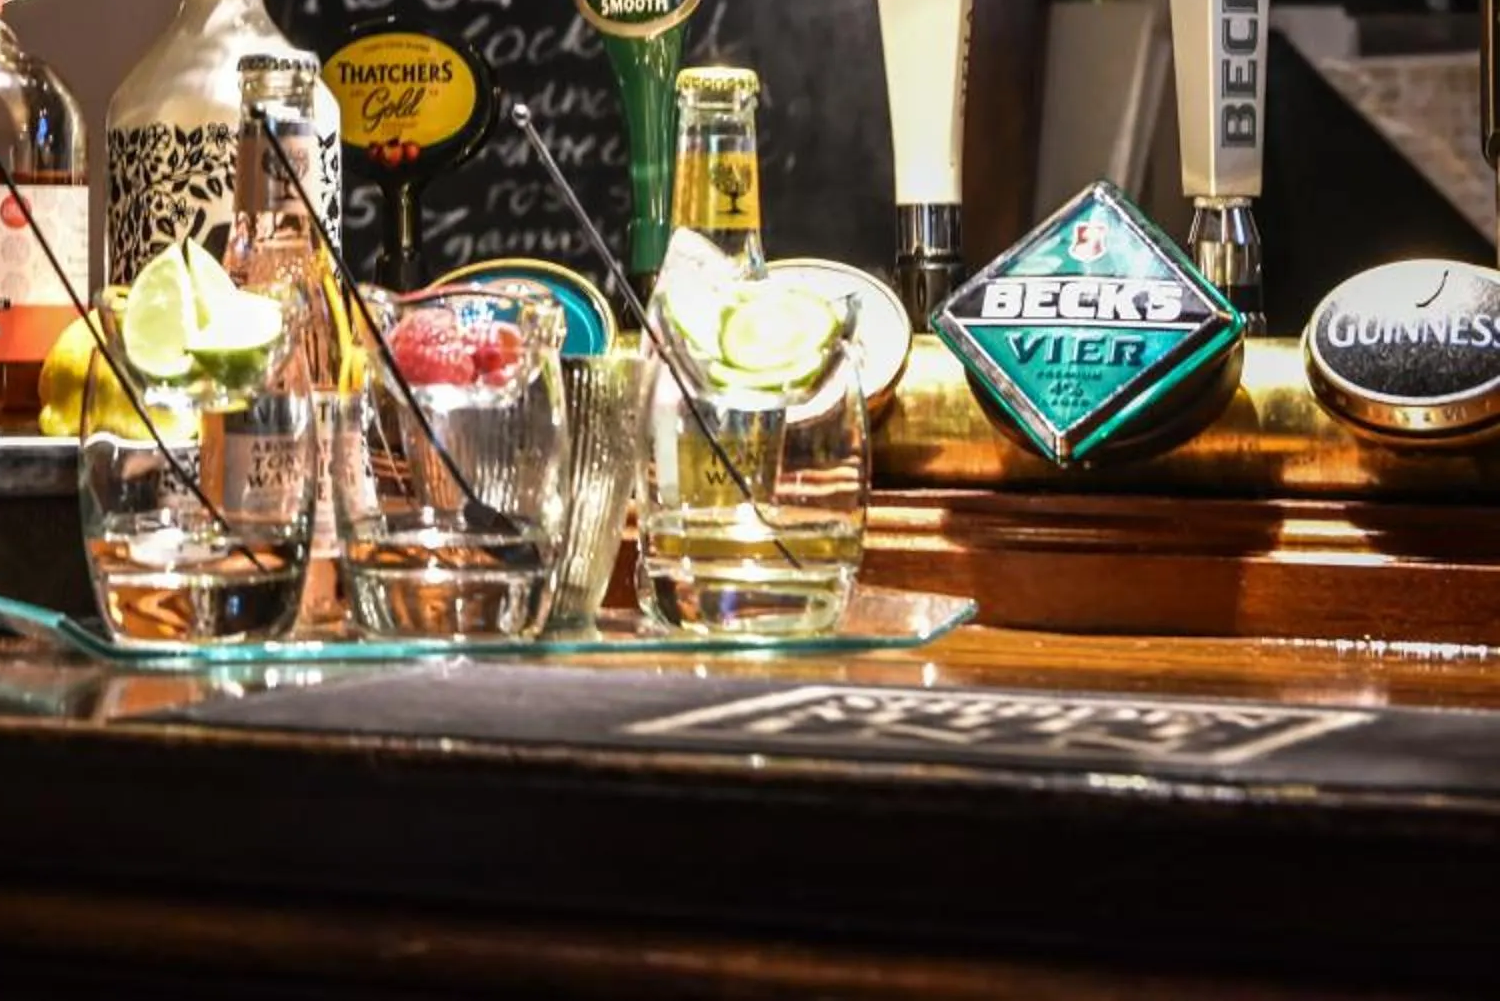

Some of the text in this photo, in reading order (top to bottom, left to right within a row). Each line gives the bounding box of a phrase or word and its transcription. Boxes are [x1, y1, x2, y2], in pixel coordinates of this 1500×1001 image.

[337, 59, 454, 85] THATCHERS
[361, 85, 427, 133] Gold
[1004, 331, 1148, 367] VIER
